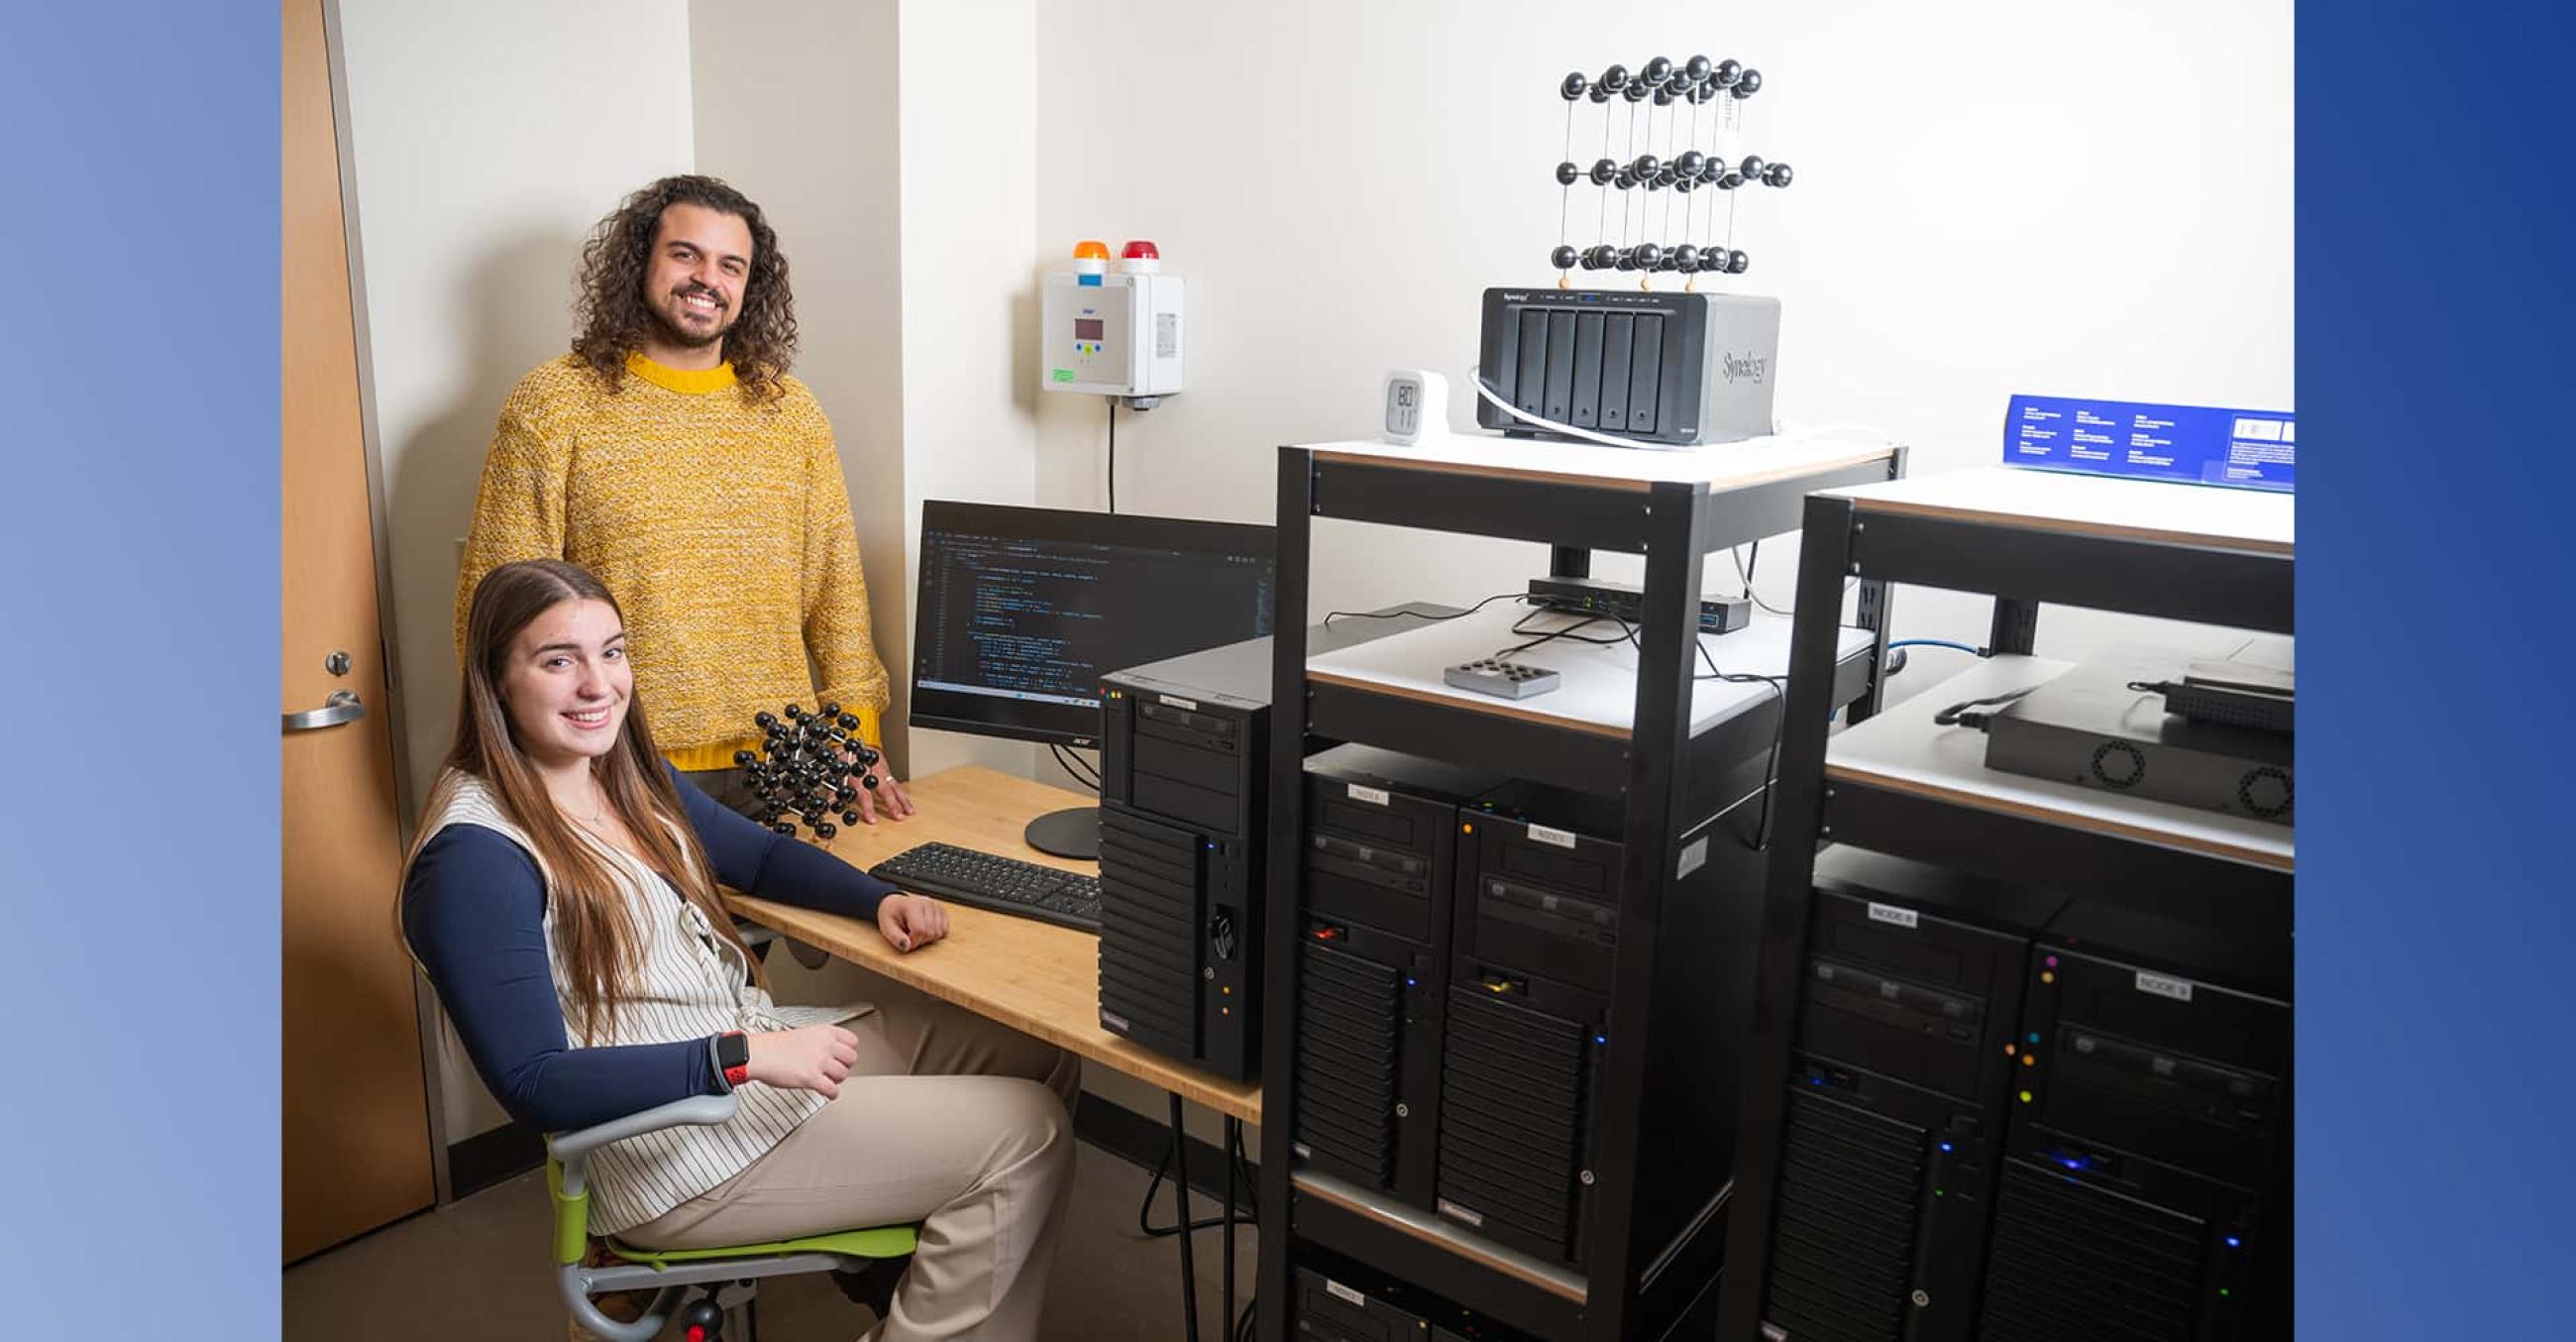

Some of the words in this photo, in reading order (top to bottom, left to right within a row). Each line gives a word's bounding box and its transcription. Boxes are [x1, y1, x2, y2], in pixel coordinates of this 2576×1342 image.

[1723, 351, 1767, 385] Synology
[1874, 907, 1901, 922] NODE
[2141, 976, 2174, 993] NODE
